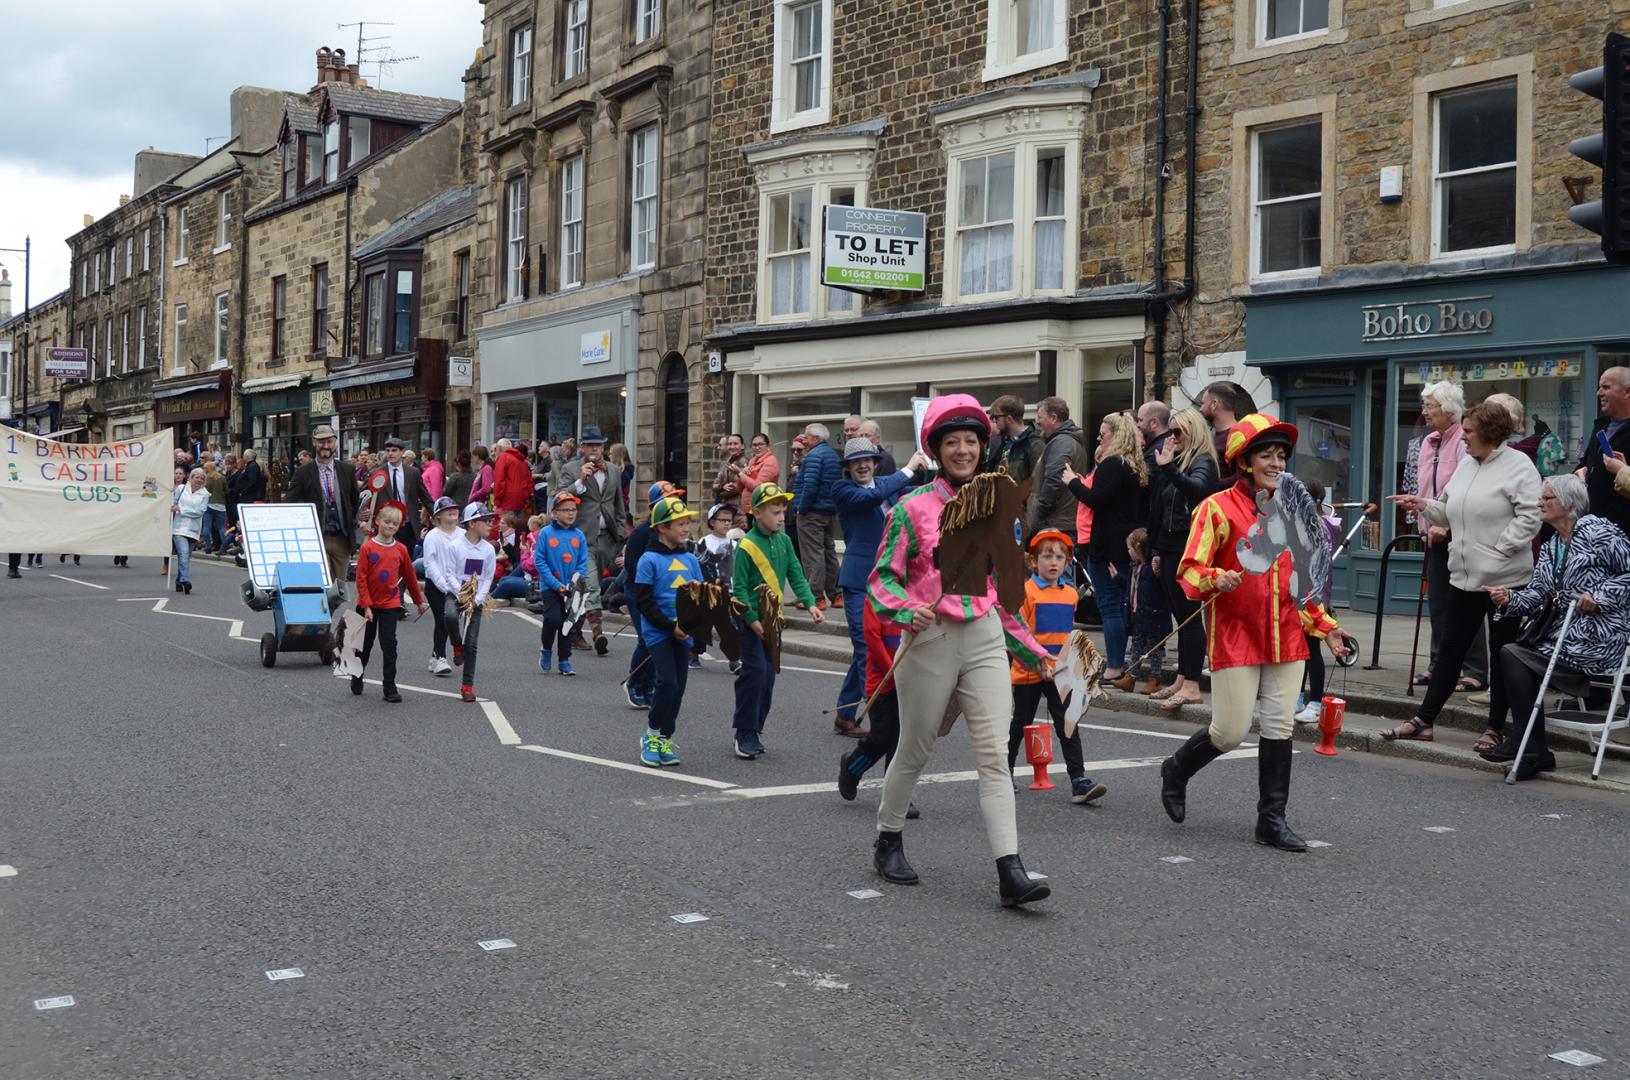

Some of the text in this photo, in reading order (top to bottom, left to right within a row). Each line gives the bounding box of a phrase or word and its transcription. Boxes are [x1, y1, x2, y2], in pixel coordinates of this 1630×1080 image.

[845, 210, 899, 222] CONNECT
[845, 222, 907, 235] PROPERTY
[835, 234, 919, 256] TO LET
[848, 252, 906, 266] Shop Unit
[841, 269, 871, 279] 01642
[874, 271, 910, 282] 602001
[1362, 302, 1493, 338] Boho Boo
[457, 364, 467, 375] Q
[1418, 358, 1569, 383] WHITE STUFF
[36, 440, 145, 460] BARNARD
[40, 463, 127, 482] CASTLE
[62, 485, 122, 503] CUBS
